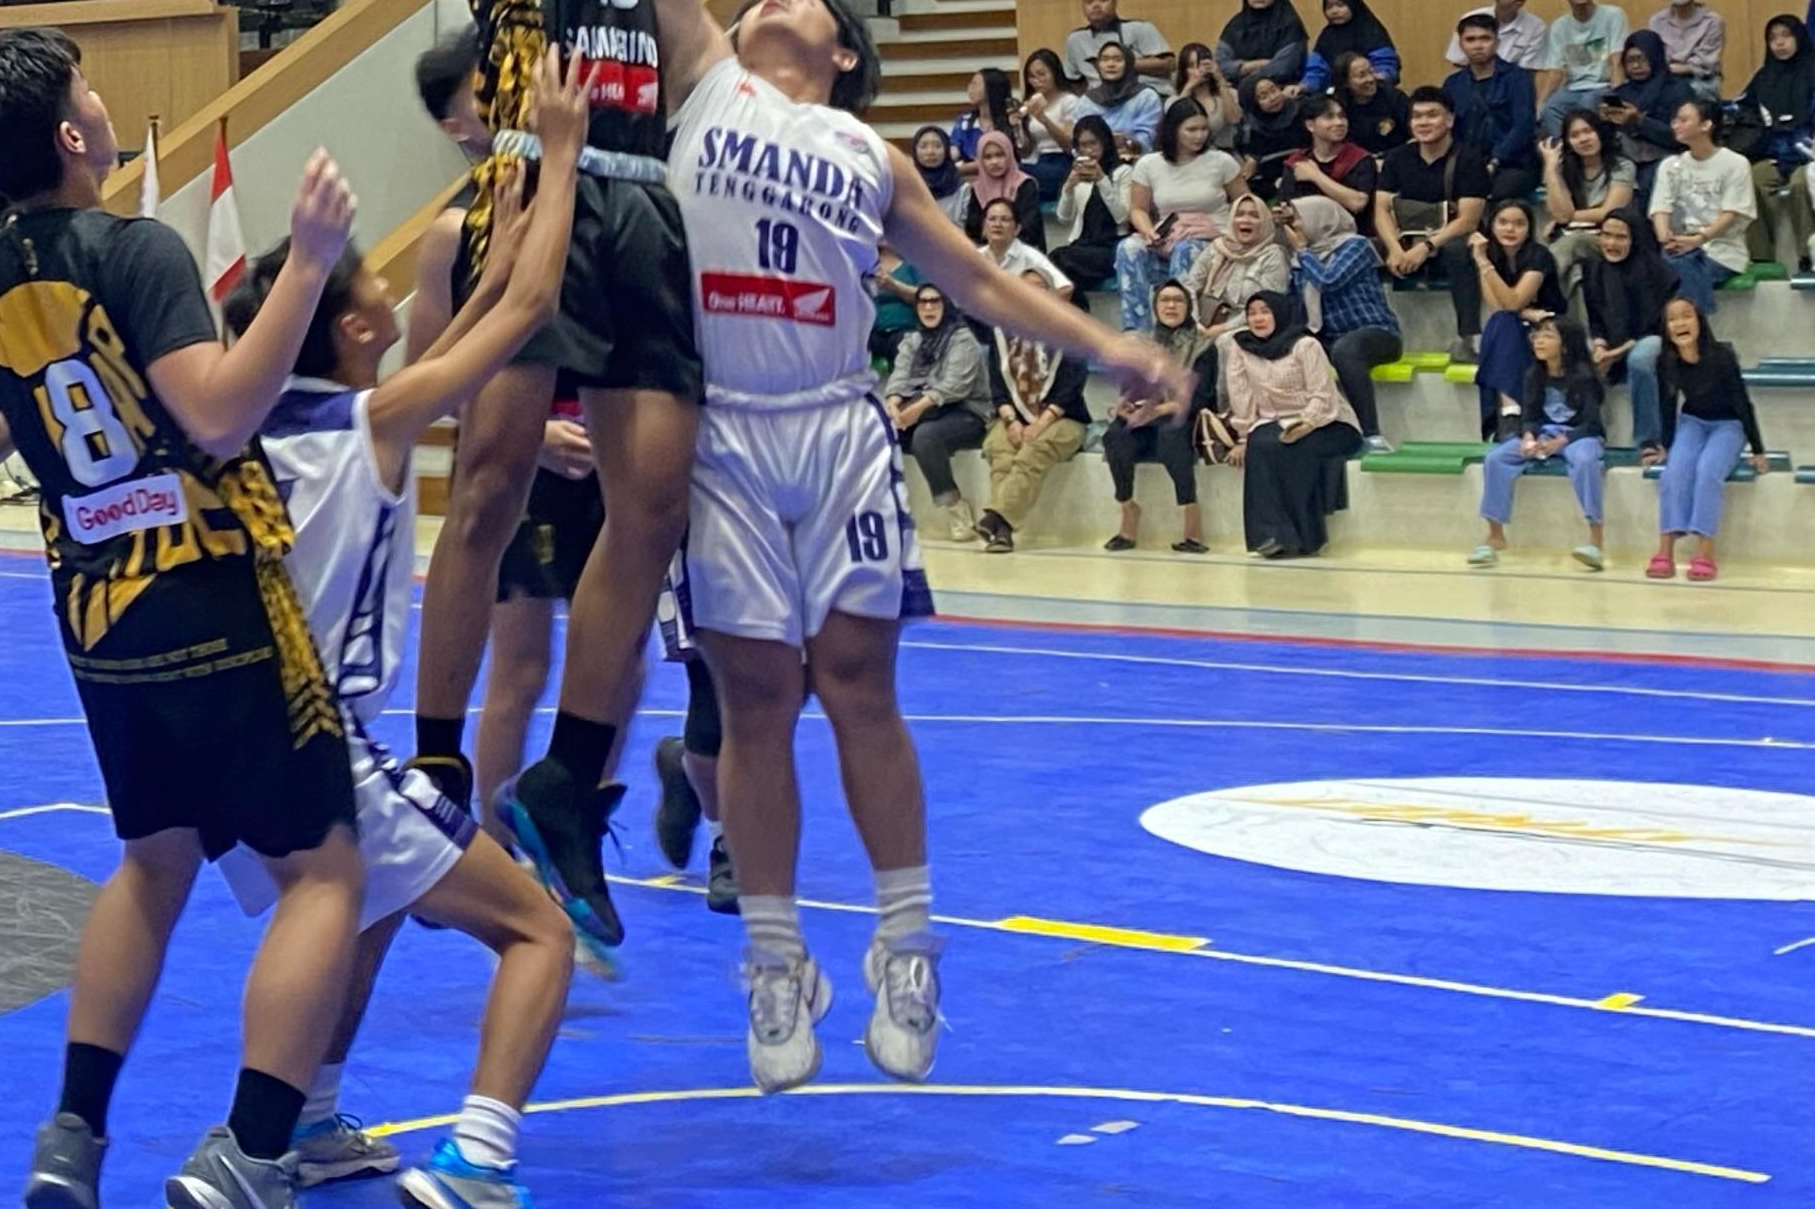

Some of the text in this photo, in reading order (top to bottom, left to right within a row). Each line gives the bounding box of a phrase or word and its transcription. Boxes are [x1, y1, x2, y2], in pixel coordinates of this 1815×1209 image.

[698, 125, 864, 210] SMANDA
[694, 171, 862, 233] TENGGARONG
[755, 217, 800, 275] 19
[43, 356, 142, 489] 8
[846, 509, 889, 563] 19
